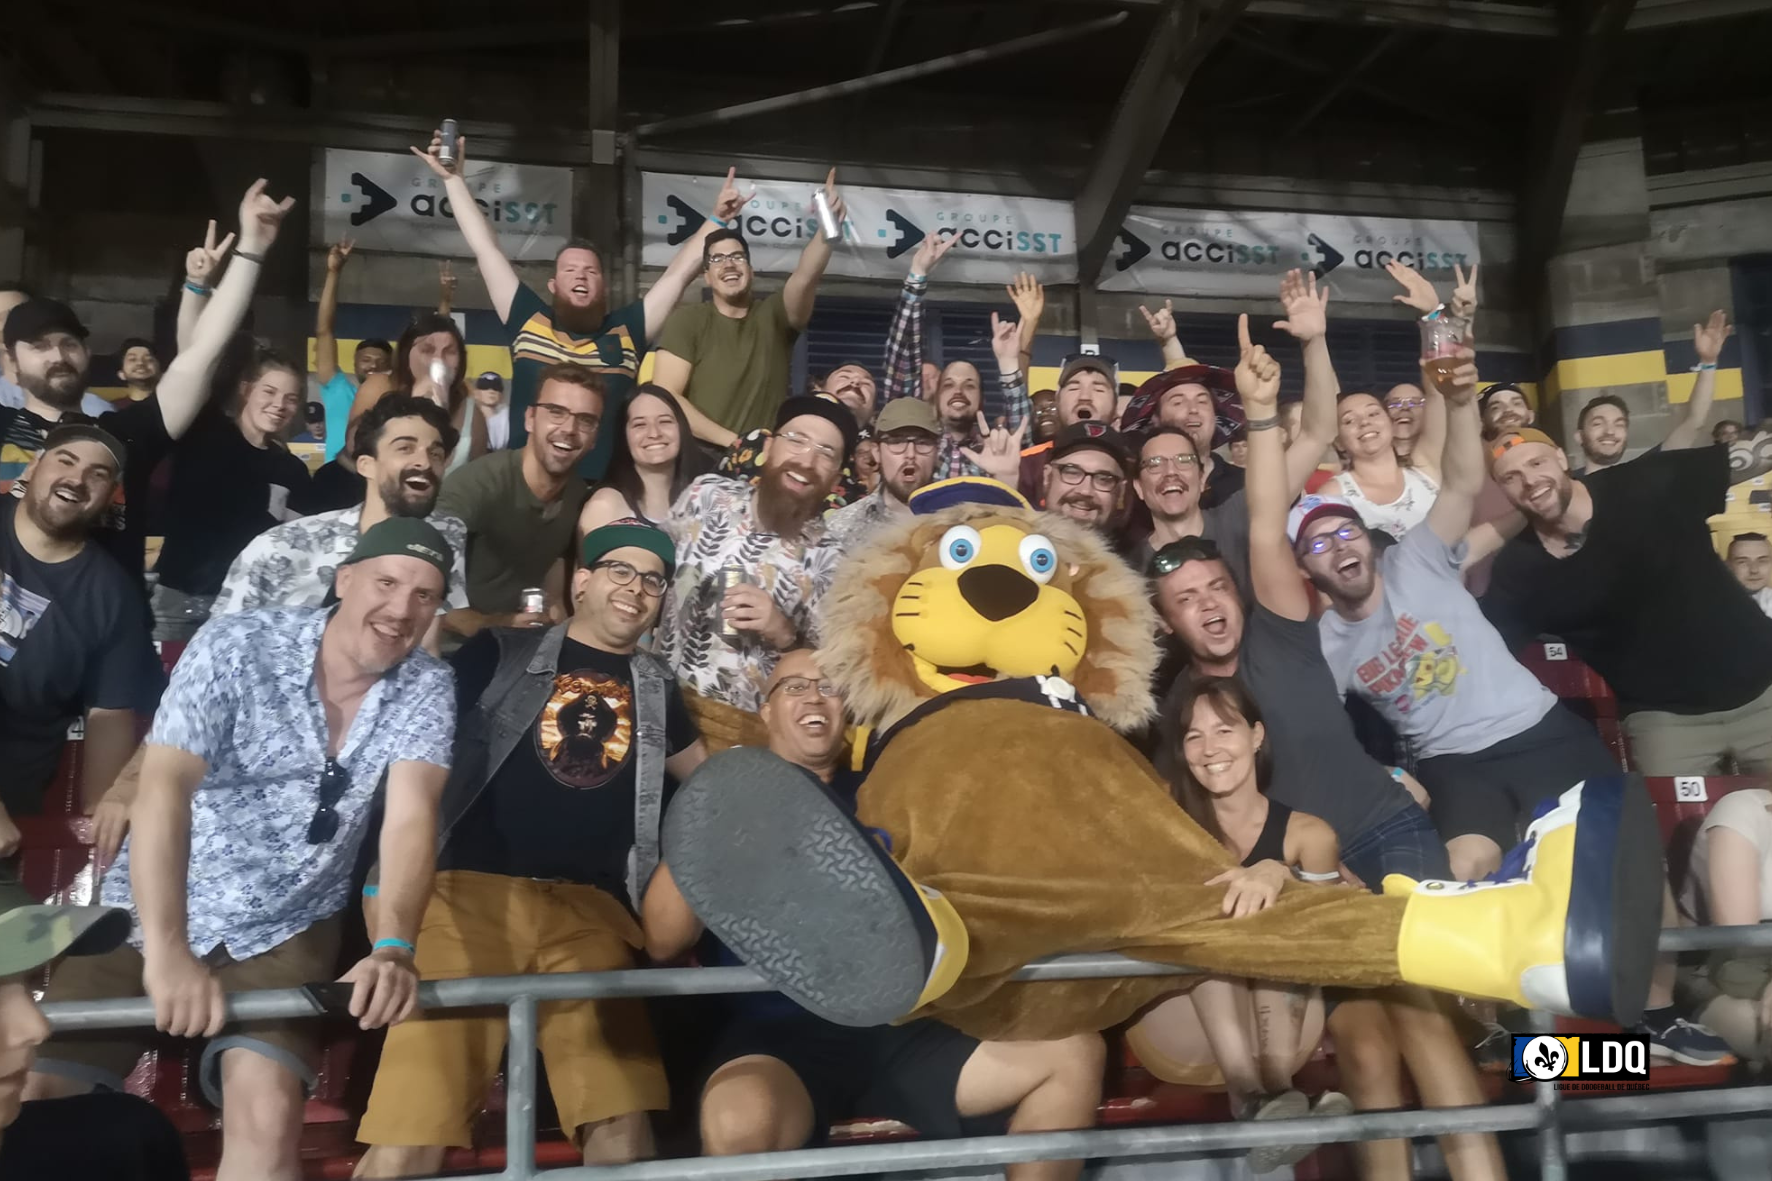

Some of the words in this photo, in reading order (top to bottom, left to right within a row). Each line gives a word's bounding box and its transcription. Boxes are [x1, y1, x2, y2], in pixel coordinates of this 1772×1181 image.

[410, 176, 502, 194] GRPE
[936, 211, 1013, 225] GROUPE
[1549, 646, 1564, 657] 54
[1679, 781, 1702, 797] 50
